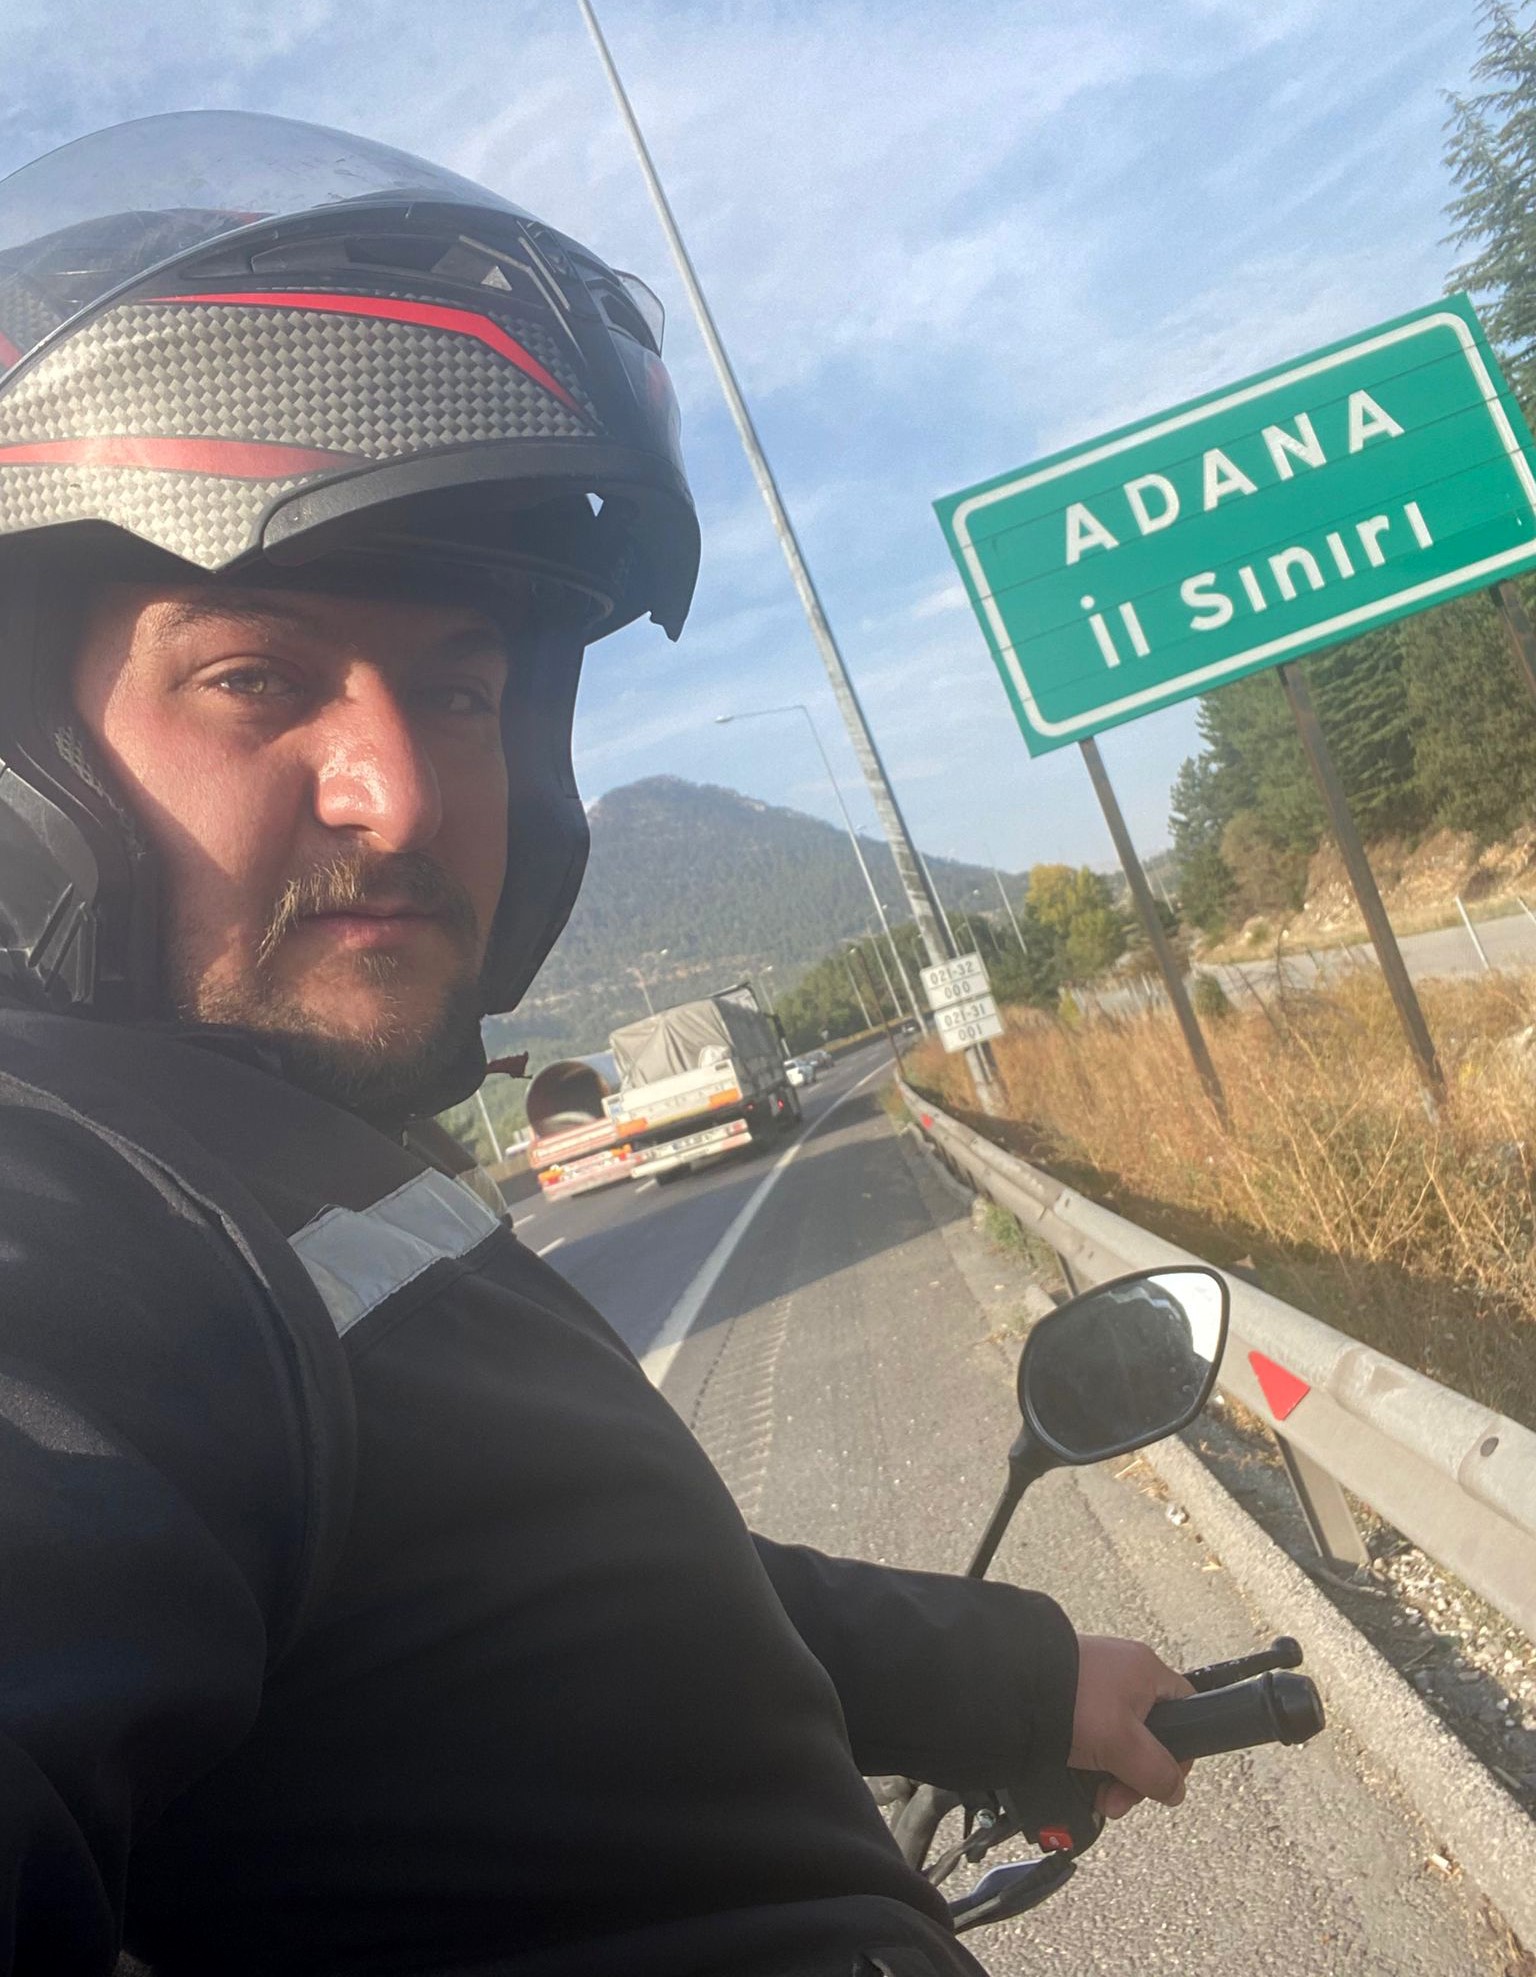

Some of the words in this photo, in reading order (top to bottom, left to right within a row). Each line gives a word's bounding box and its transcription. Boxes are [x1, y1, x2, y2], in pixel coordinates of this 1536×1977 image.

[1065, 389, 1405, 565] ADANA
[929, 961, 974, 985] 021-32
[944, 981, 970, 999] 000
[944, 1003, 985, 1027] 021-31
[958, 1023, 983, 1041] 001
